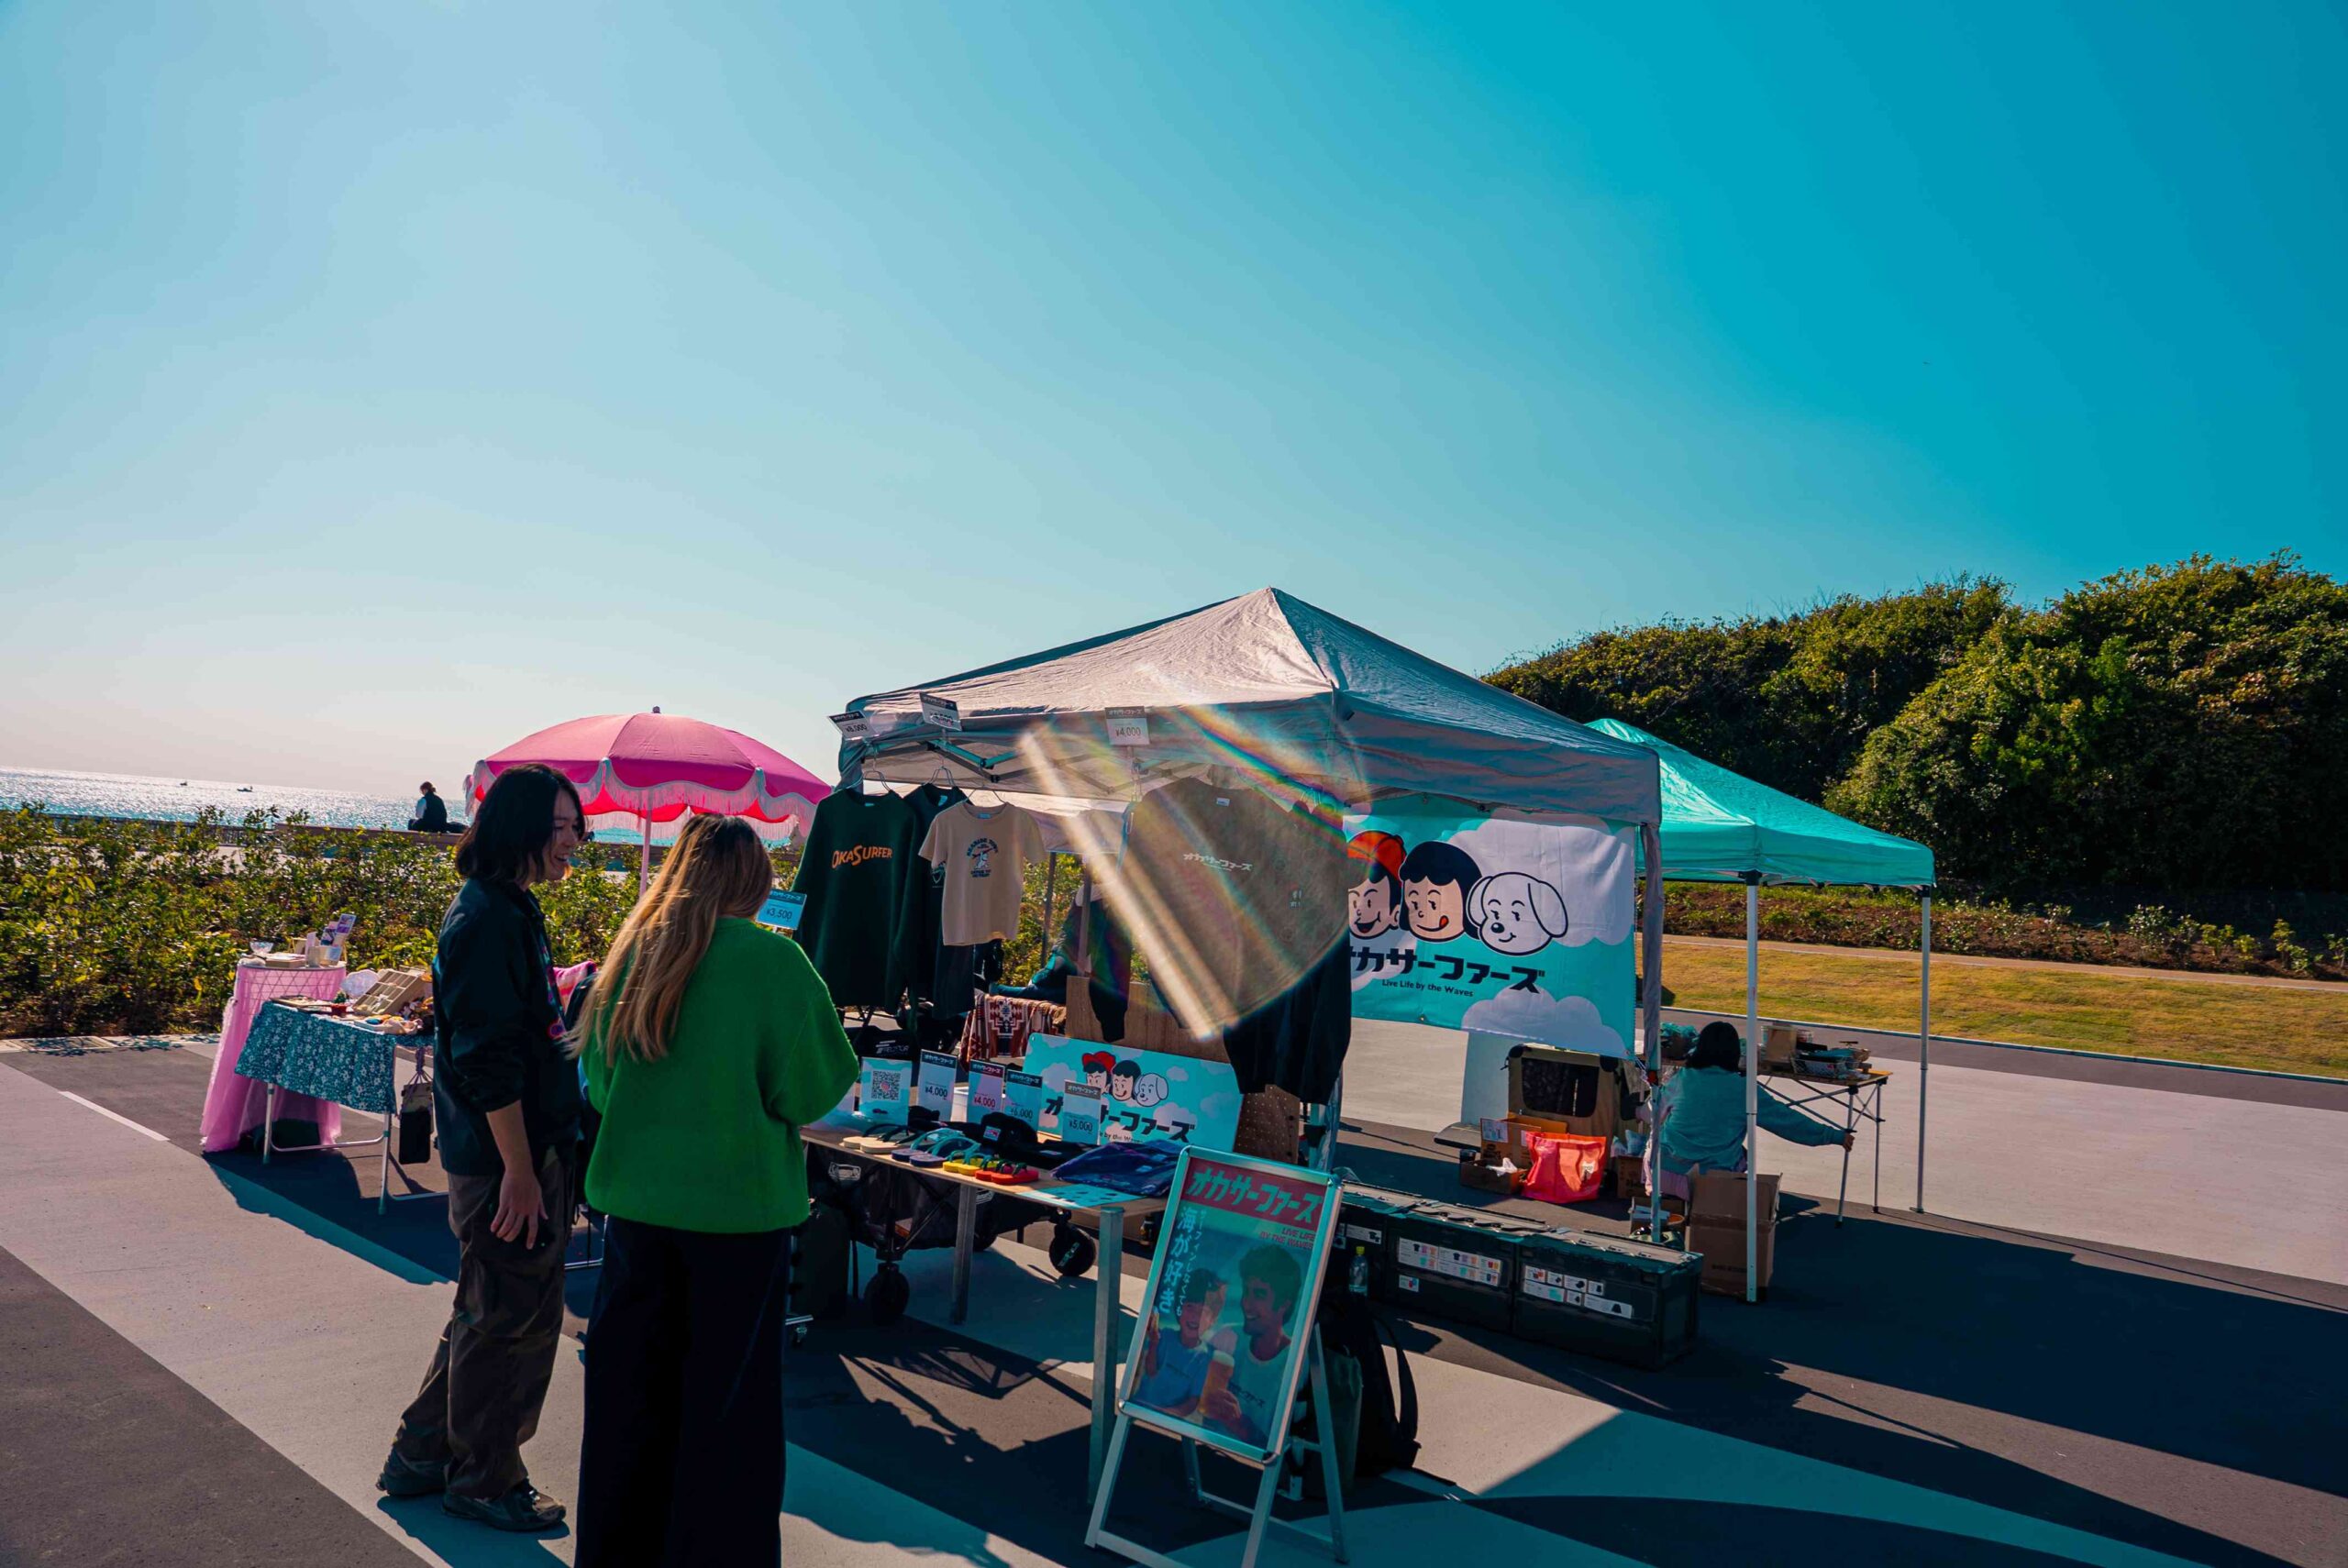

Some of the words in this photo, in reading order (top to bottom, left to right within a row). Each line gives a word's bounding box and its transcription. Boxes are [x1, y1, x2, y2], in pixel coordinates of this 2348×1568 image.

[1115, 727, 1142, 736] ¥4,000
[1381, 978, 1398, 988] Live
[1400, 980, 1414, 988] Life
[1415, 982, 1425, 991] by
[1427, 983, 1442, 992] the
[1444, 986, 1474, 998] Waves
[925, 1085, 948, 1097] ¥4,000
[974, 1097, 996, 1108] ¥4,000
[1069, 1120, 1093, 1132] ¥5,000
[1187, 1167, 1324, 1224] オカサーファーズ
[1158, 1206, 1198, 1314] 海が好き
